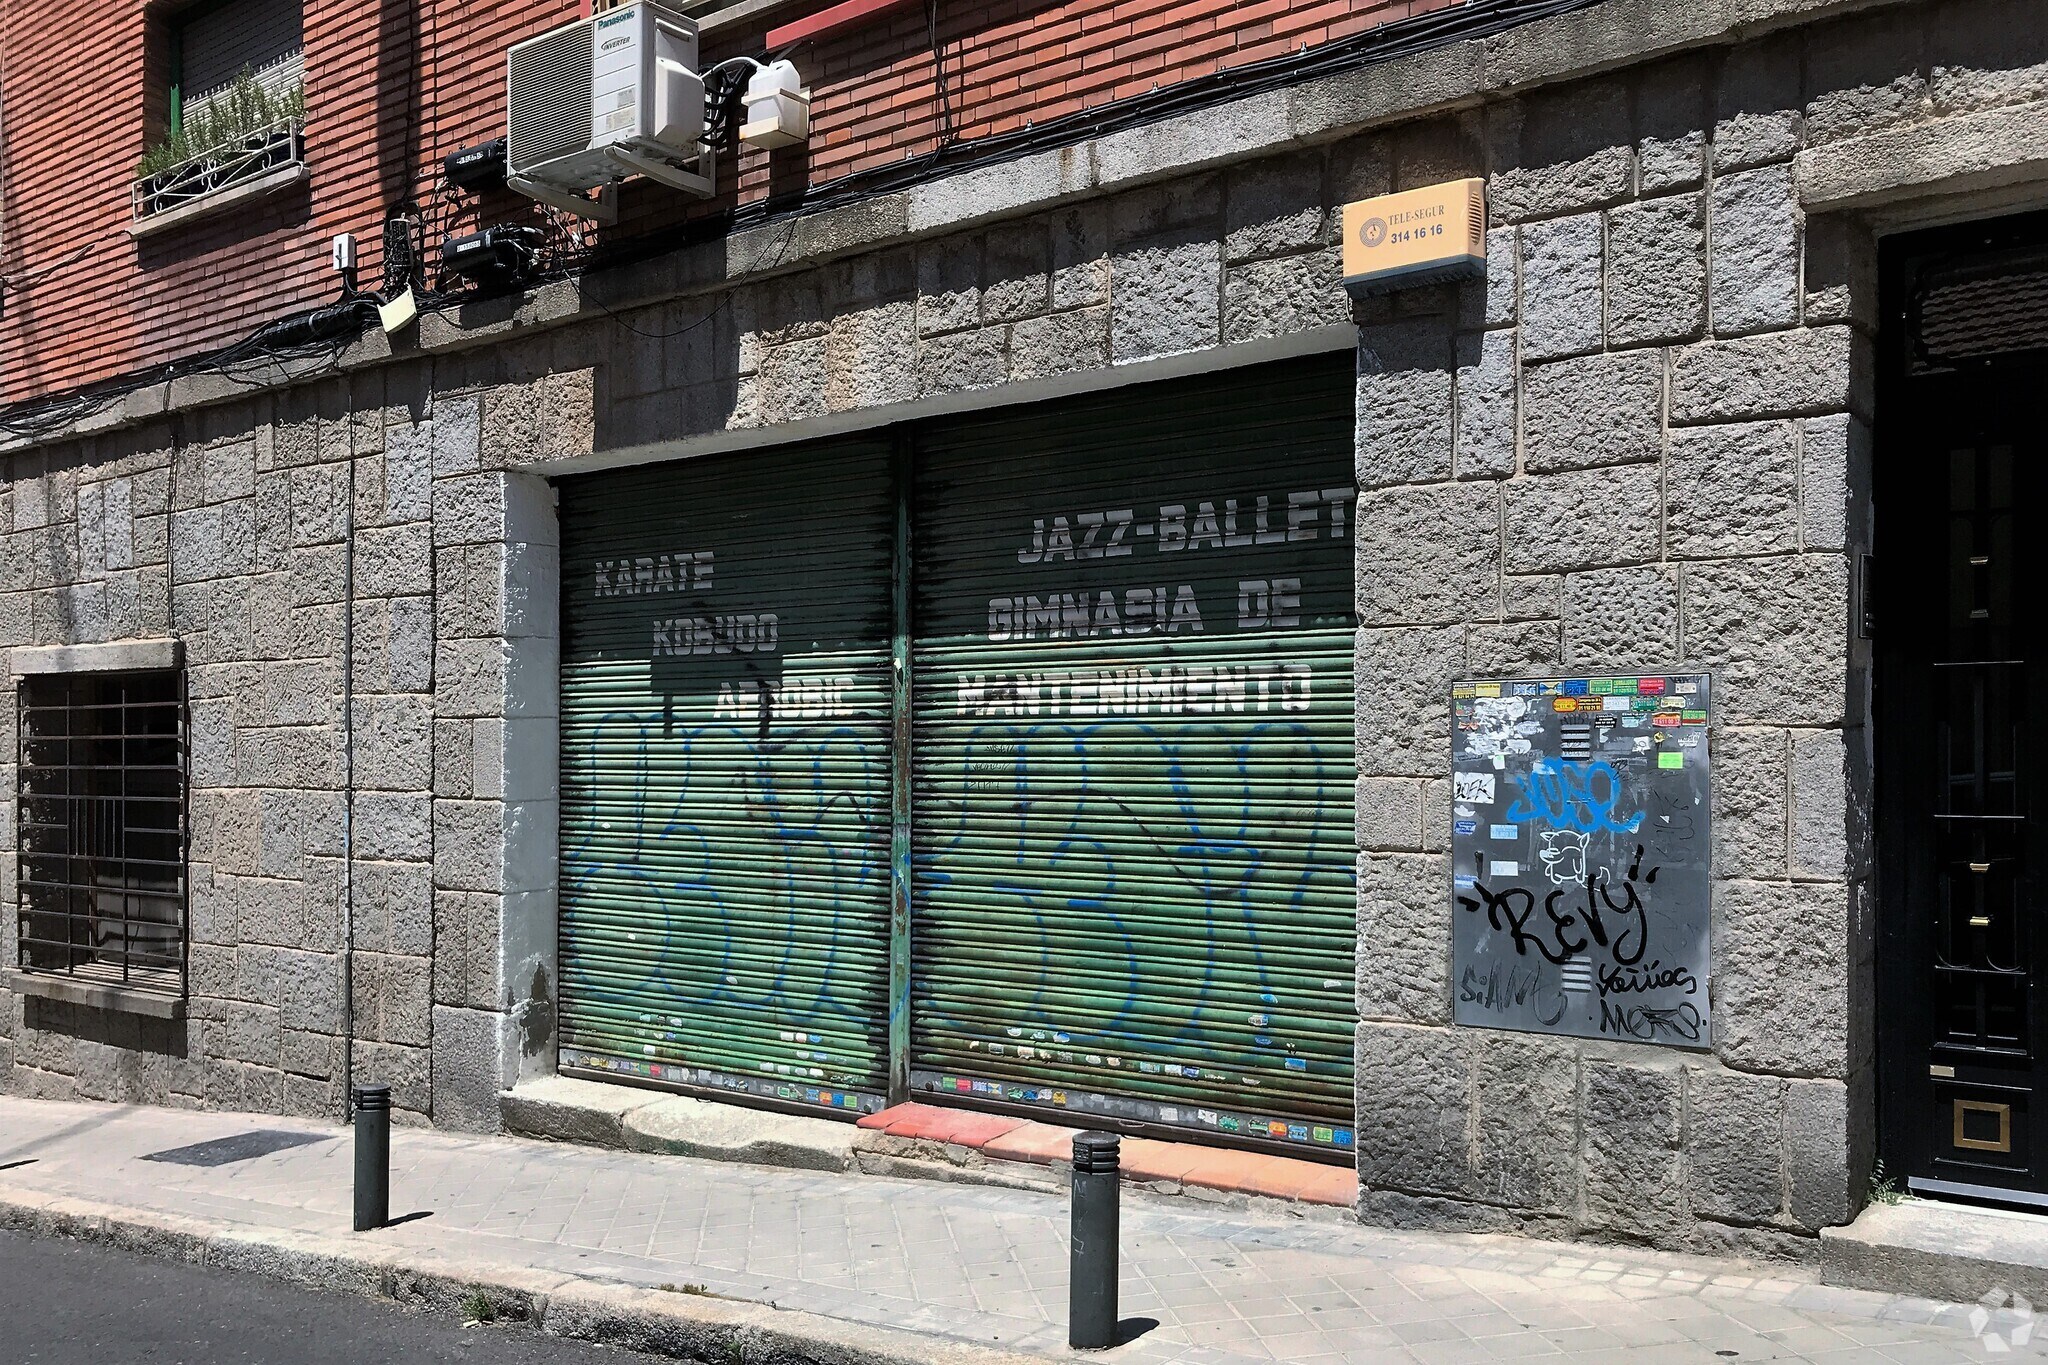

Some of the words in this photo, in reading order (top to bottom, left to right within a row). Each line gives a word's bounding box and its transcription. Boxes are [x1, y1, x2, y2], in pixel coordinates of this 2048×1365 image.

[598, 10, 635, 30] Panasonic
[603, 36, 631, 51] INVERTER
[1388, 205, 1445, 226] TELE-SEGUR
[1391, 231, 1410, 244] 314
[1414, 228, 1426, 240] 16
[1430, 224, 1443, 236] 16
[1017, 487, 1355, 563] JAZZ-BALLET
[594, 551, 715, 597] KARATE
[988, 584, 1205, 641] GIMNASIA
[1238, 578, 1301, 628] DE
[652, 613, 779, 656] KOBUDO
[957, 664, 1312, 716] MANTENIMIENTO
